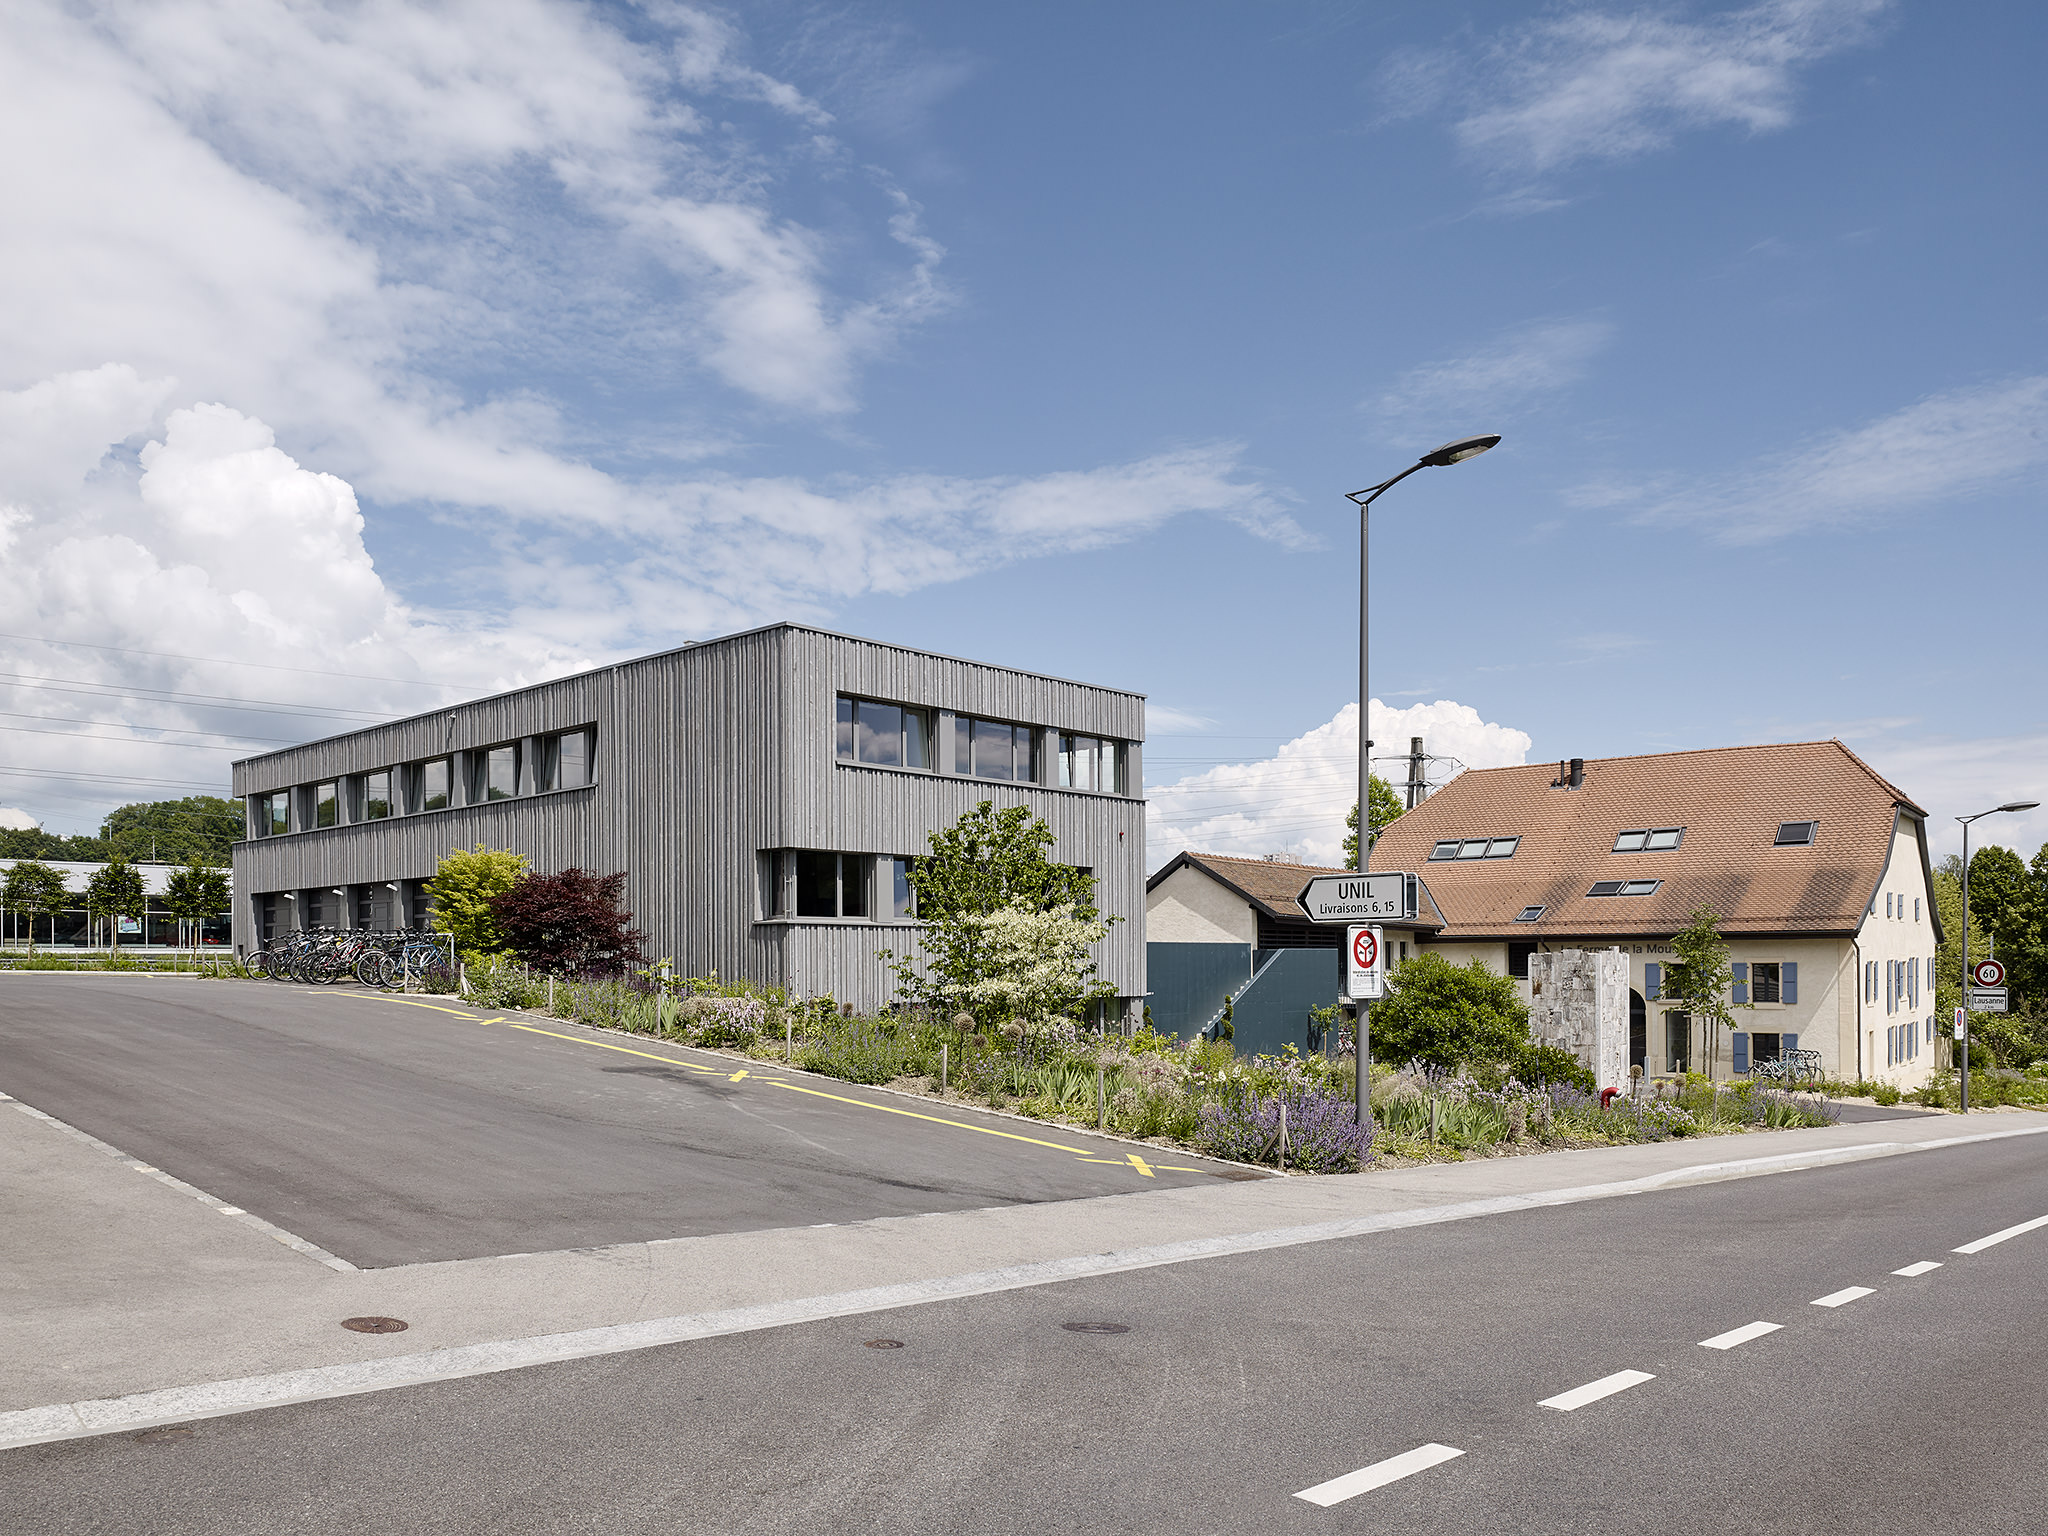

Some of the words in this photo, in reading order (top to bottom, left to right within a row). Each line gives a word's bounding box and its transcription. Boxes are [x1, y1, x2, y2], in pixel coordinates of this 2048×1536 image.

[1338, 882, 1374, 899] UNIL
[1319, 902, 1369, 914] Livraisons
[1371, 901, 1382, 914] 6,
[1384, 901, 1394, 912] 15
[1632, 943, 1643, 954] la
[1983, 969, 1995, 978] 60
